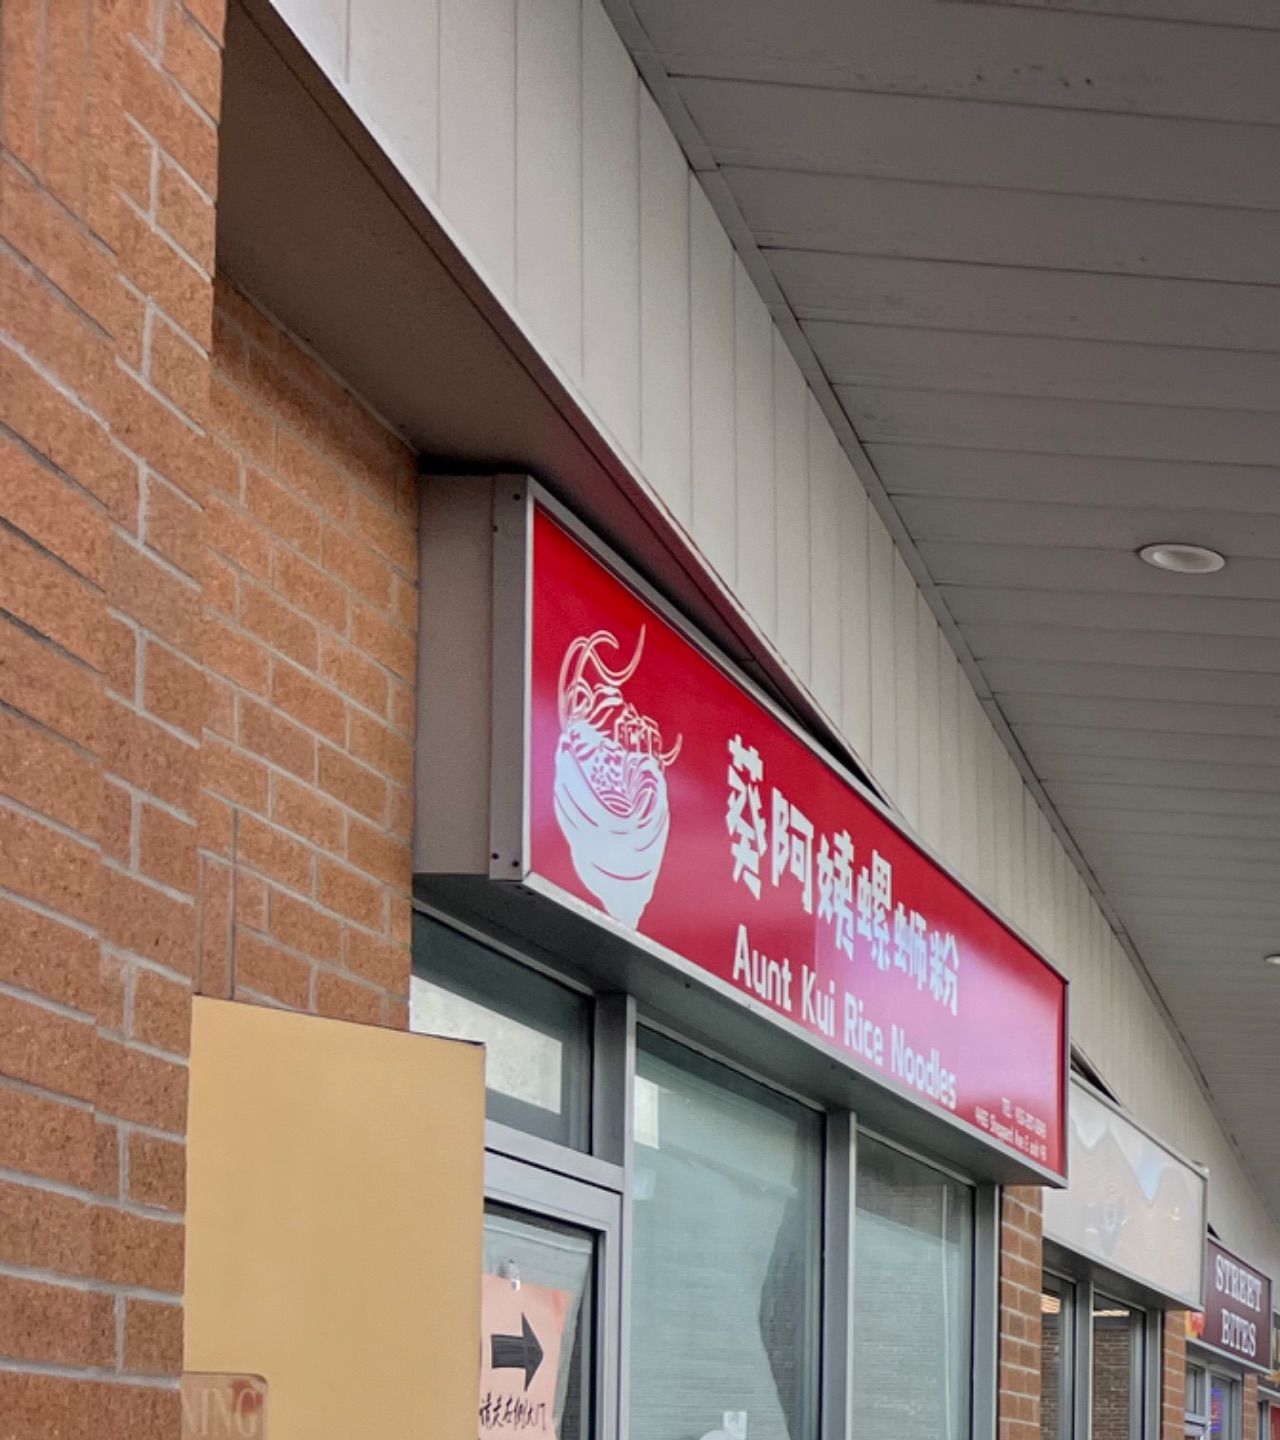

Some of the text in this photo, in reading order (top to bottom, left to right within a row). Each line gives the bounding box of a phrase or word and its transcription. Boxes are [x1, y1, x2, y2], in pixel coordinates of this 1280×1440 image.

[732, 923, 957, 1110] Aunt Kui Rice Noodles
[1214, 1254, 1262, 1313] STREET
[1220, 1308, 1257, 1358] BITES
